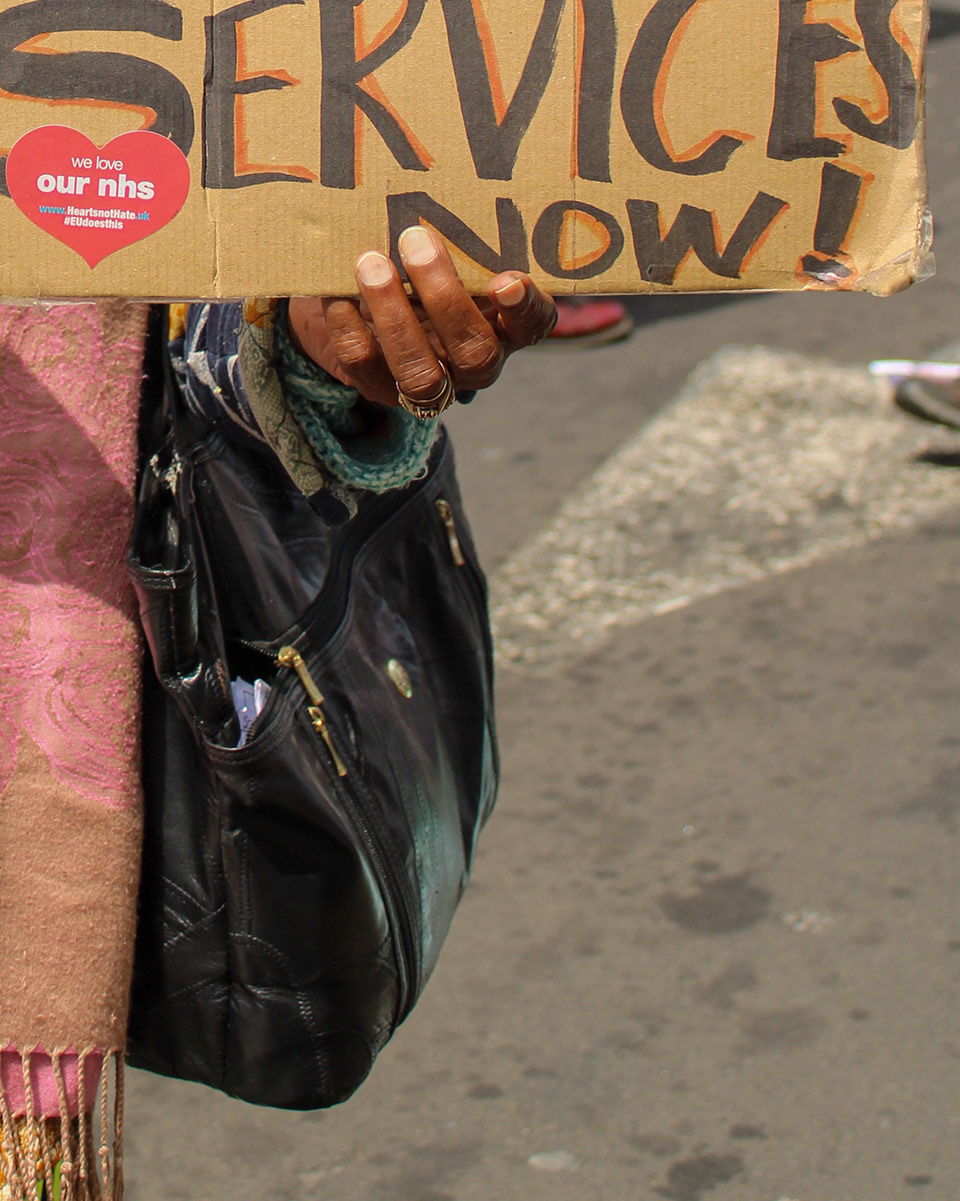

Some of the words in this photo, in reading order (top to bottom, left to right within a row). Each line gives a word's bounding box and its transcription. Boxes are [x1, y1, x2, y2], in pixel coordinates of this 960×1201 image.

[71, 156, 93, 169] we
[95, 155, 124, 171] love
[36, 173, 91, 195] our
[98, 173, 155, 200] nhs
[39, 205, 150, 221] www.HeartsnotHate.uk
[64, 216, 124, 230] #EUdoesthis
